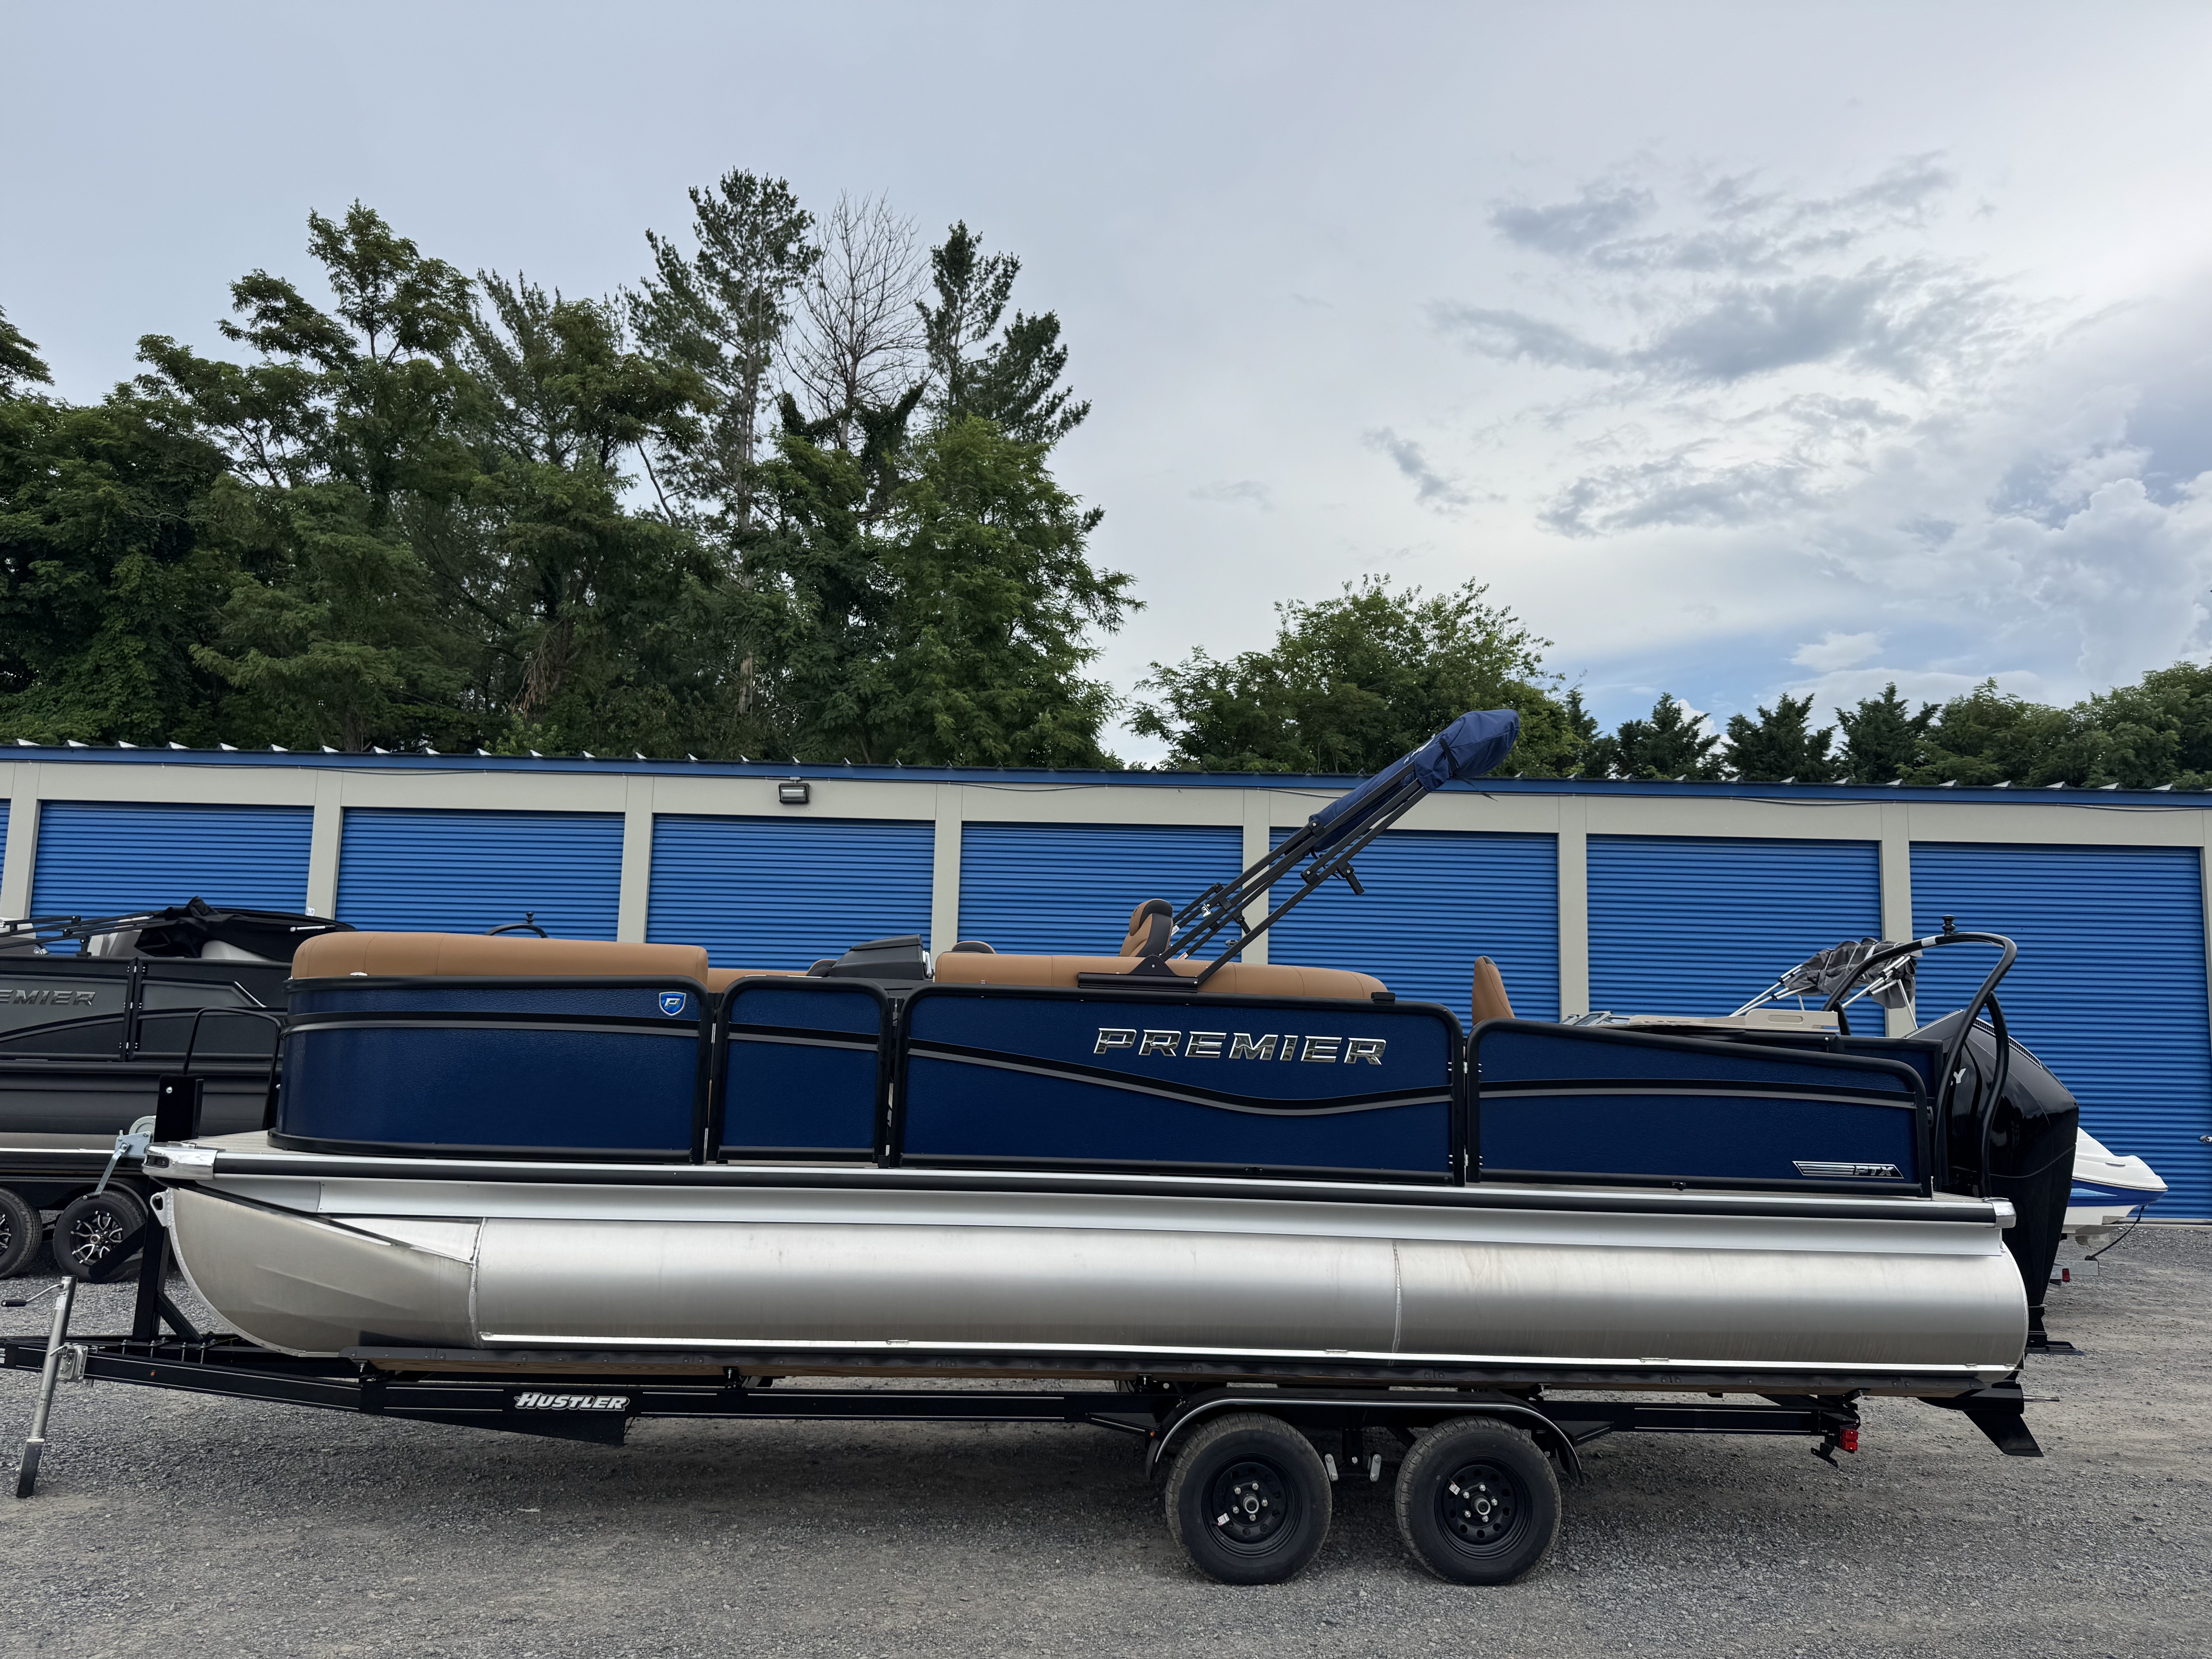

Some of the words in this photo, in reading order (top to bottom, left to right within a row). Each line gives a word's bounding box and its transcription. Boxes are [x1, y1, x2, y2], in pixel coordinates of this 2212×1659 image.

[1093, 1027, 1386, 1065] PREMIER
[1854, 1165, 1894, 1176] PTX
[515, 1393, 629, 1410] HUSTLER
